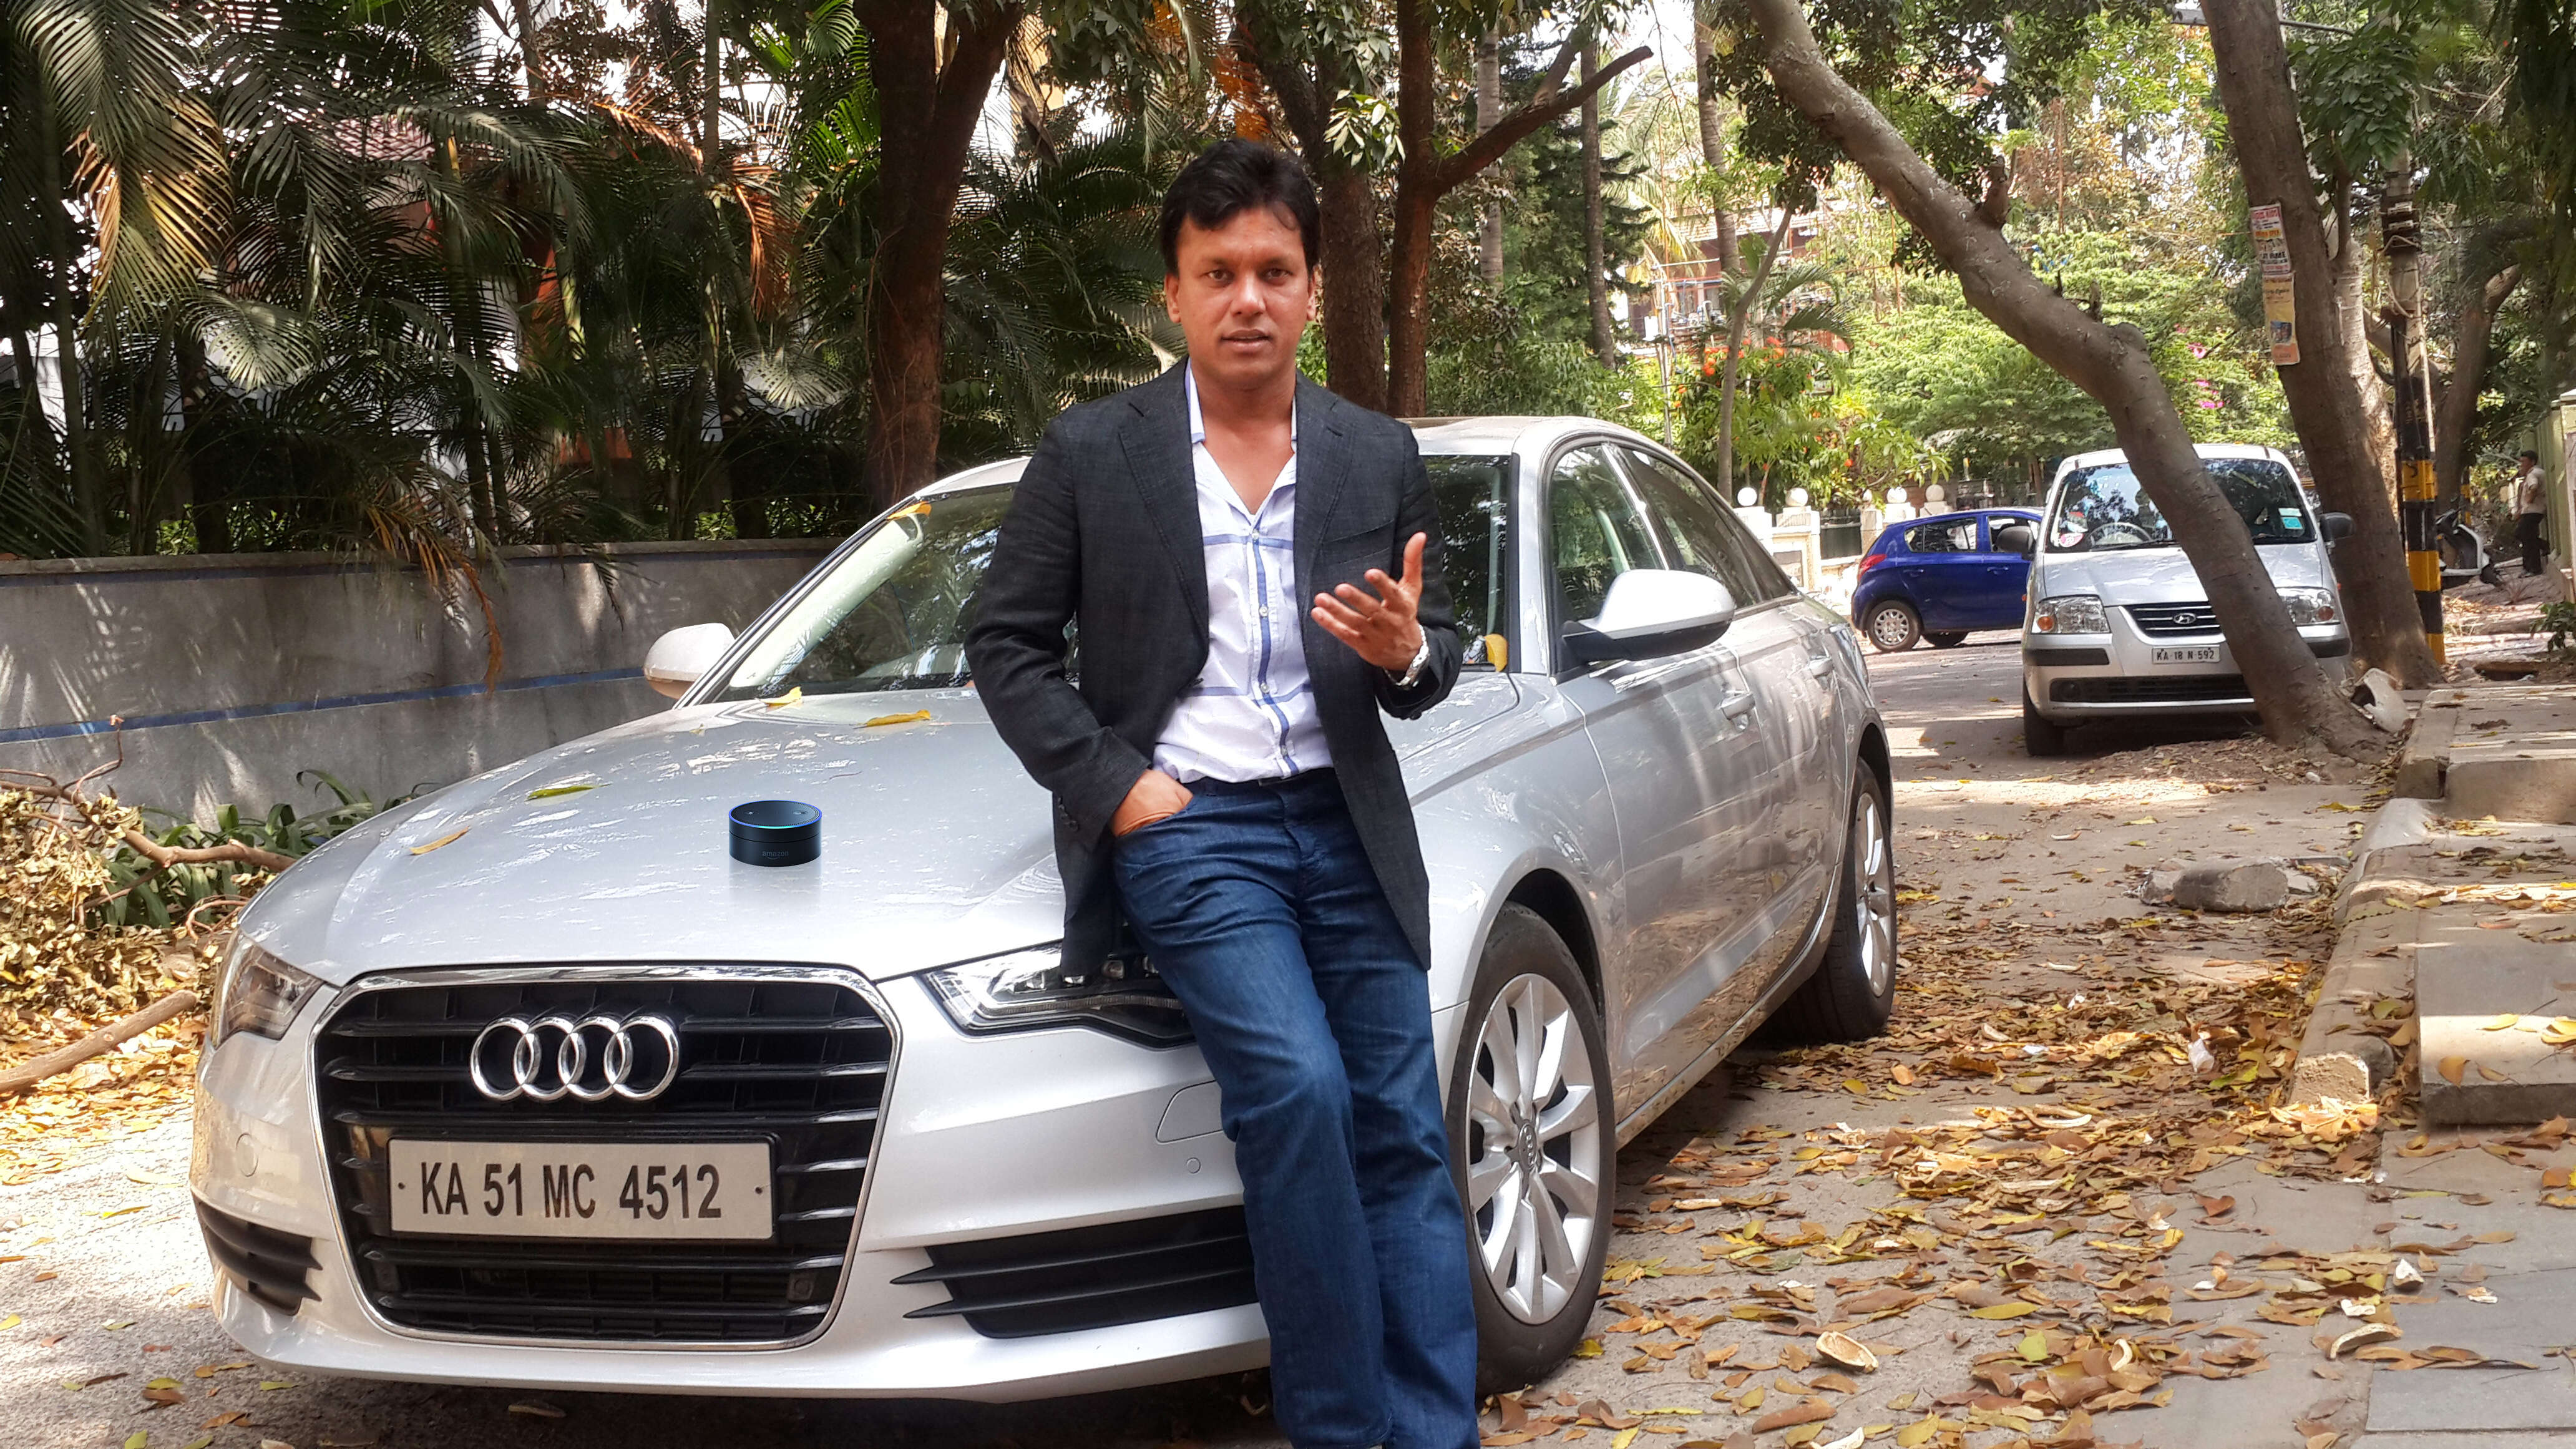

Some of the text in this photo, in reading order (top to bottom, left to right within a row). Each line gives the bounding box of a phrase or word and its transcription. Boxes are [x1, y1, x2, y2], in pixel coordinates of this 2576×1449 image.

[421, 1161, 721, 1220] KA 51 MC 4512
